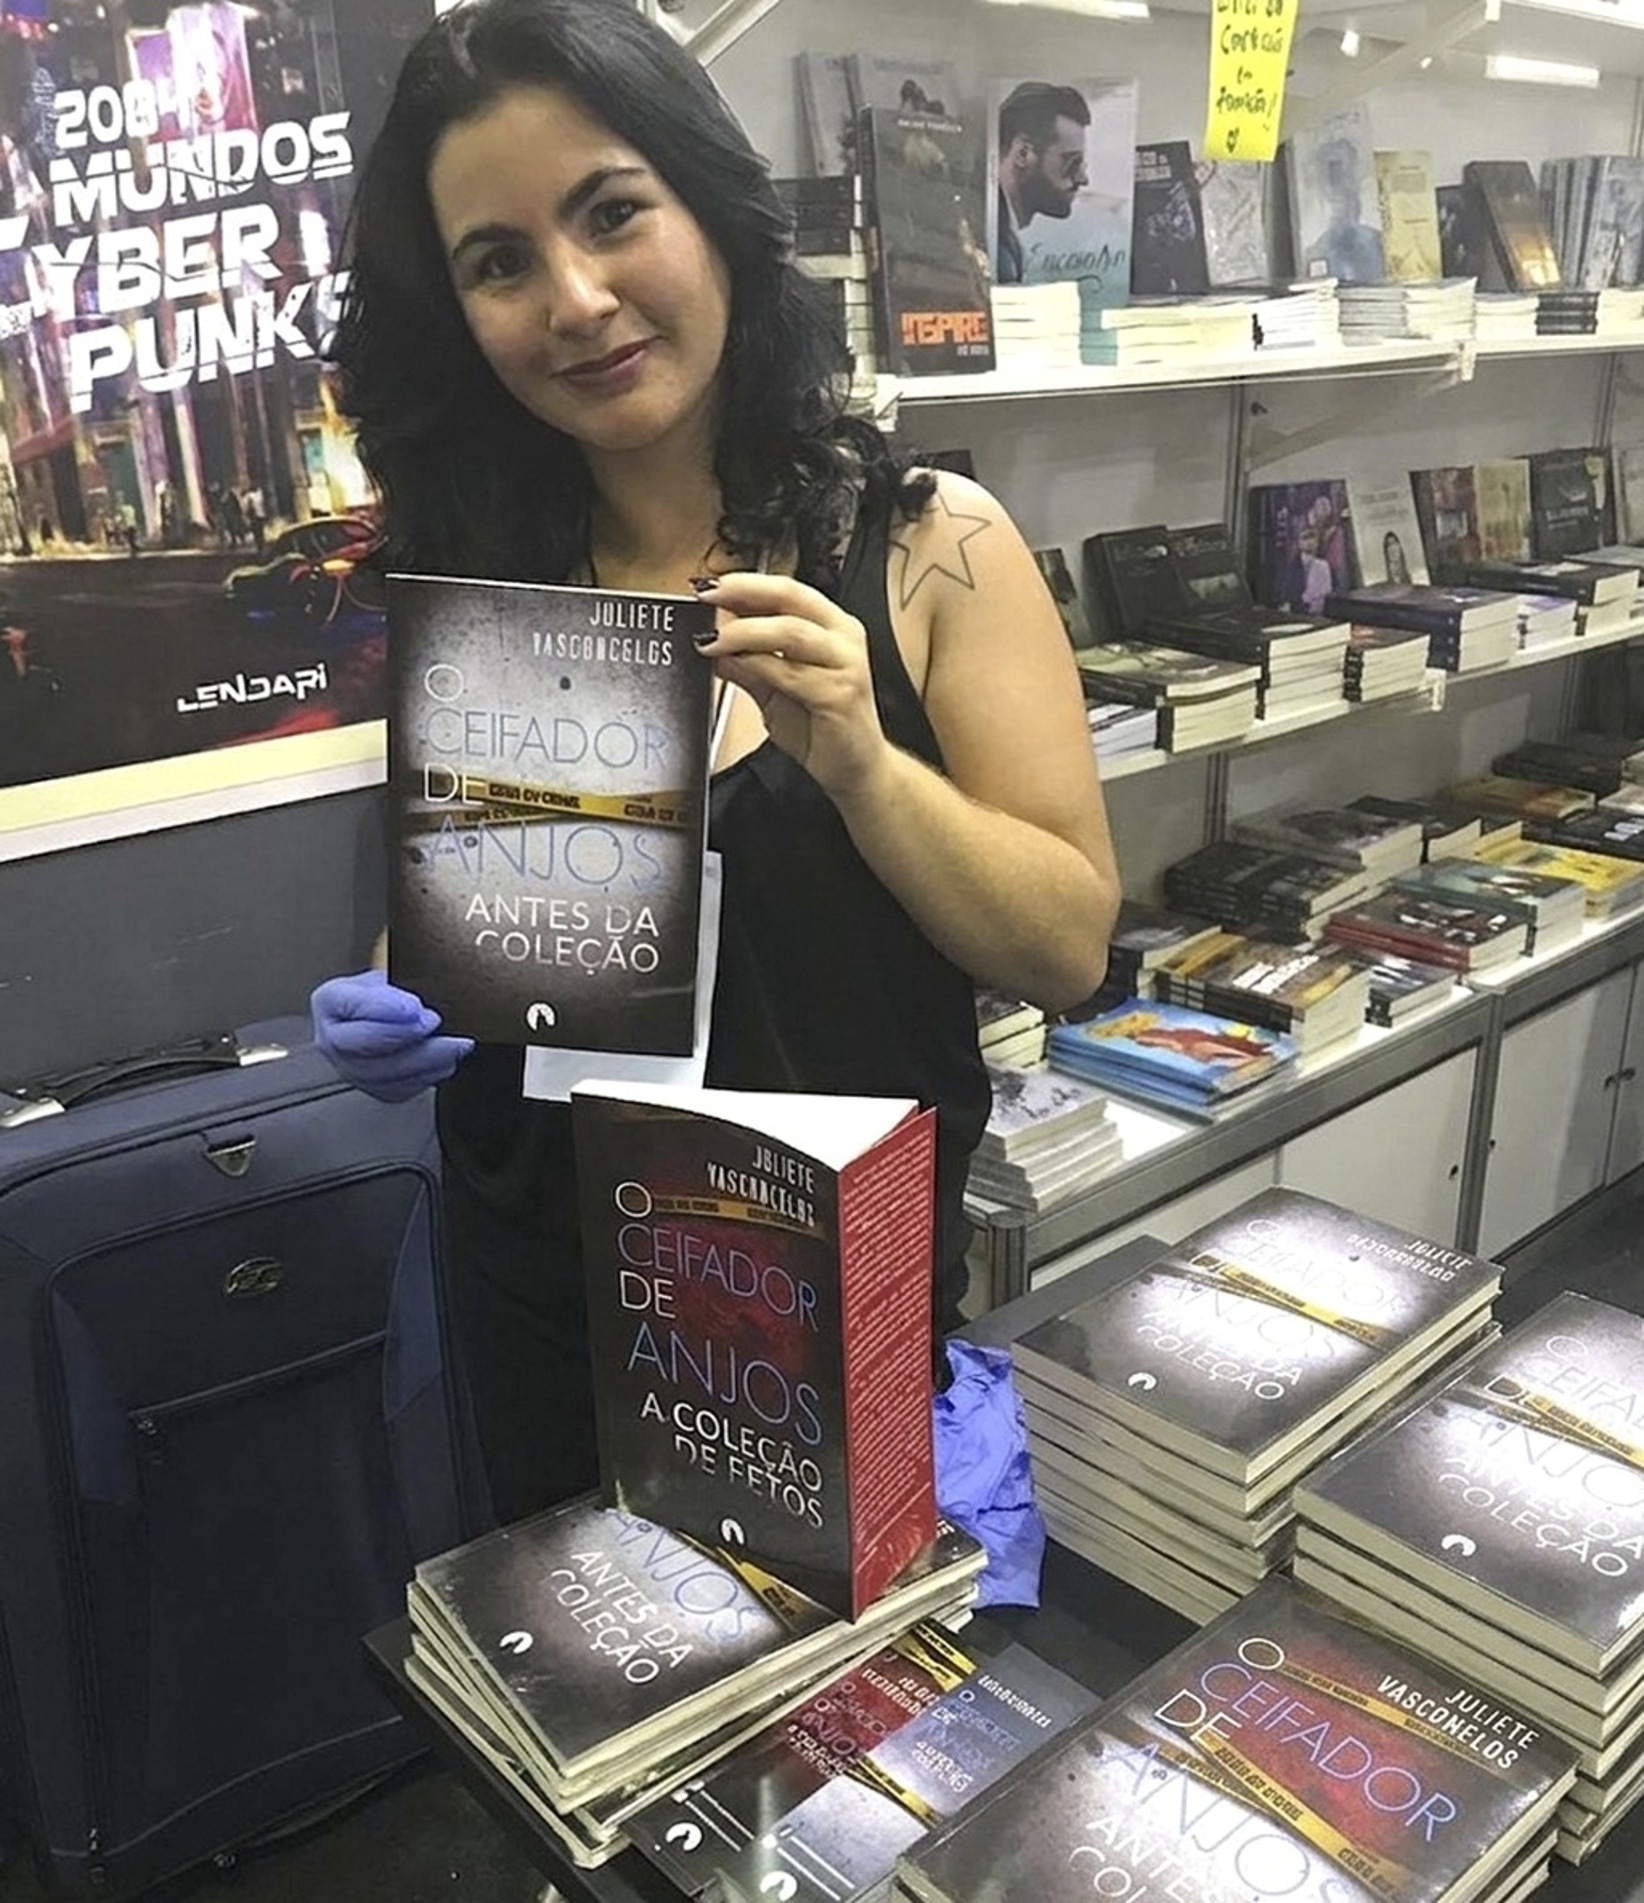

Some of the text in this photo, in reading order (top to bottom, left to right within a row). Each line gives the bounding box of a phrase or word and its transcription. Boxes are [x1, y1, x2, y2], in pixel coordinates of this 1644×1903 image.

[49, 111, 354, 227] MUNDOS
[589, 601, 675, 632] JULIETE
[425, 663, 464, 702] O
[426, 707, 674, 770] CEIFADOR
[424, 763, 484, 806] DE
[428, 813, 662, 891] ANJOS
[465, 893, 660, 937] ANTES DA
[475, 930, 660, 975] COLEÇÃO
[615, 1181, 652, 1218] O
[617, 1222, 820, 1333] CEIFADOR
[619, 1269, 677, 1319] DE
[628, 1320, 822, 1446] ANJOS
[641, 1392, 822, 1492] A COLEÇÃO
[675, 1434, 823, 1529] DE FETOS
[551, 1569, 660, 1684] COLEÇÃO
[571, 1551, 694, 1668] ANTES DA
[1237, 1636, 1285, 1671] O
[1153, 1688, 1243, 1743] DE
[1444, 1689, 1540, 1749] JULIETE
[1200, 1662, 1457, 1843] CEIFADOR
